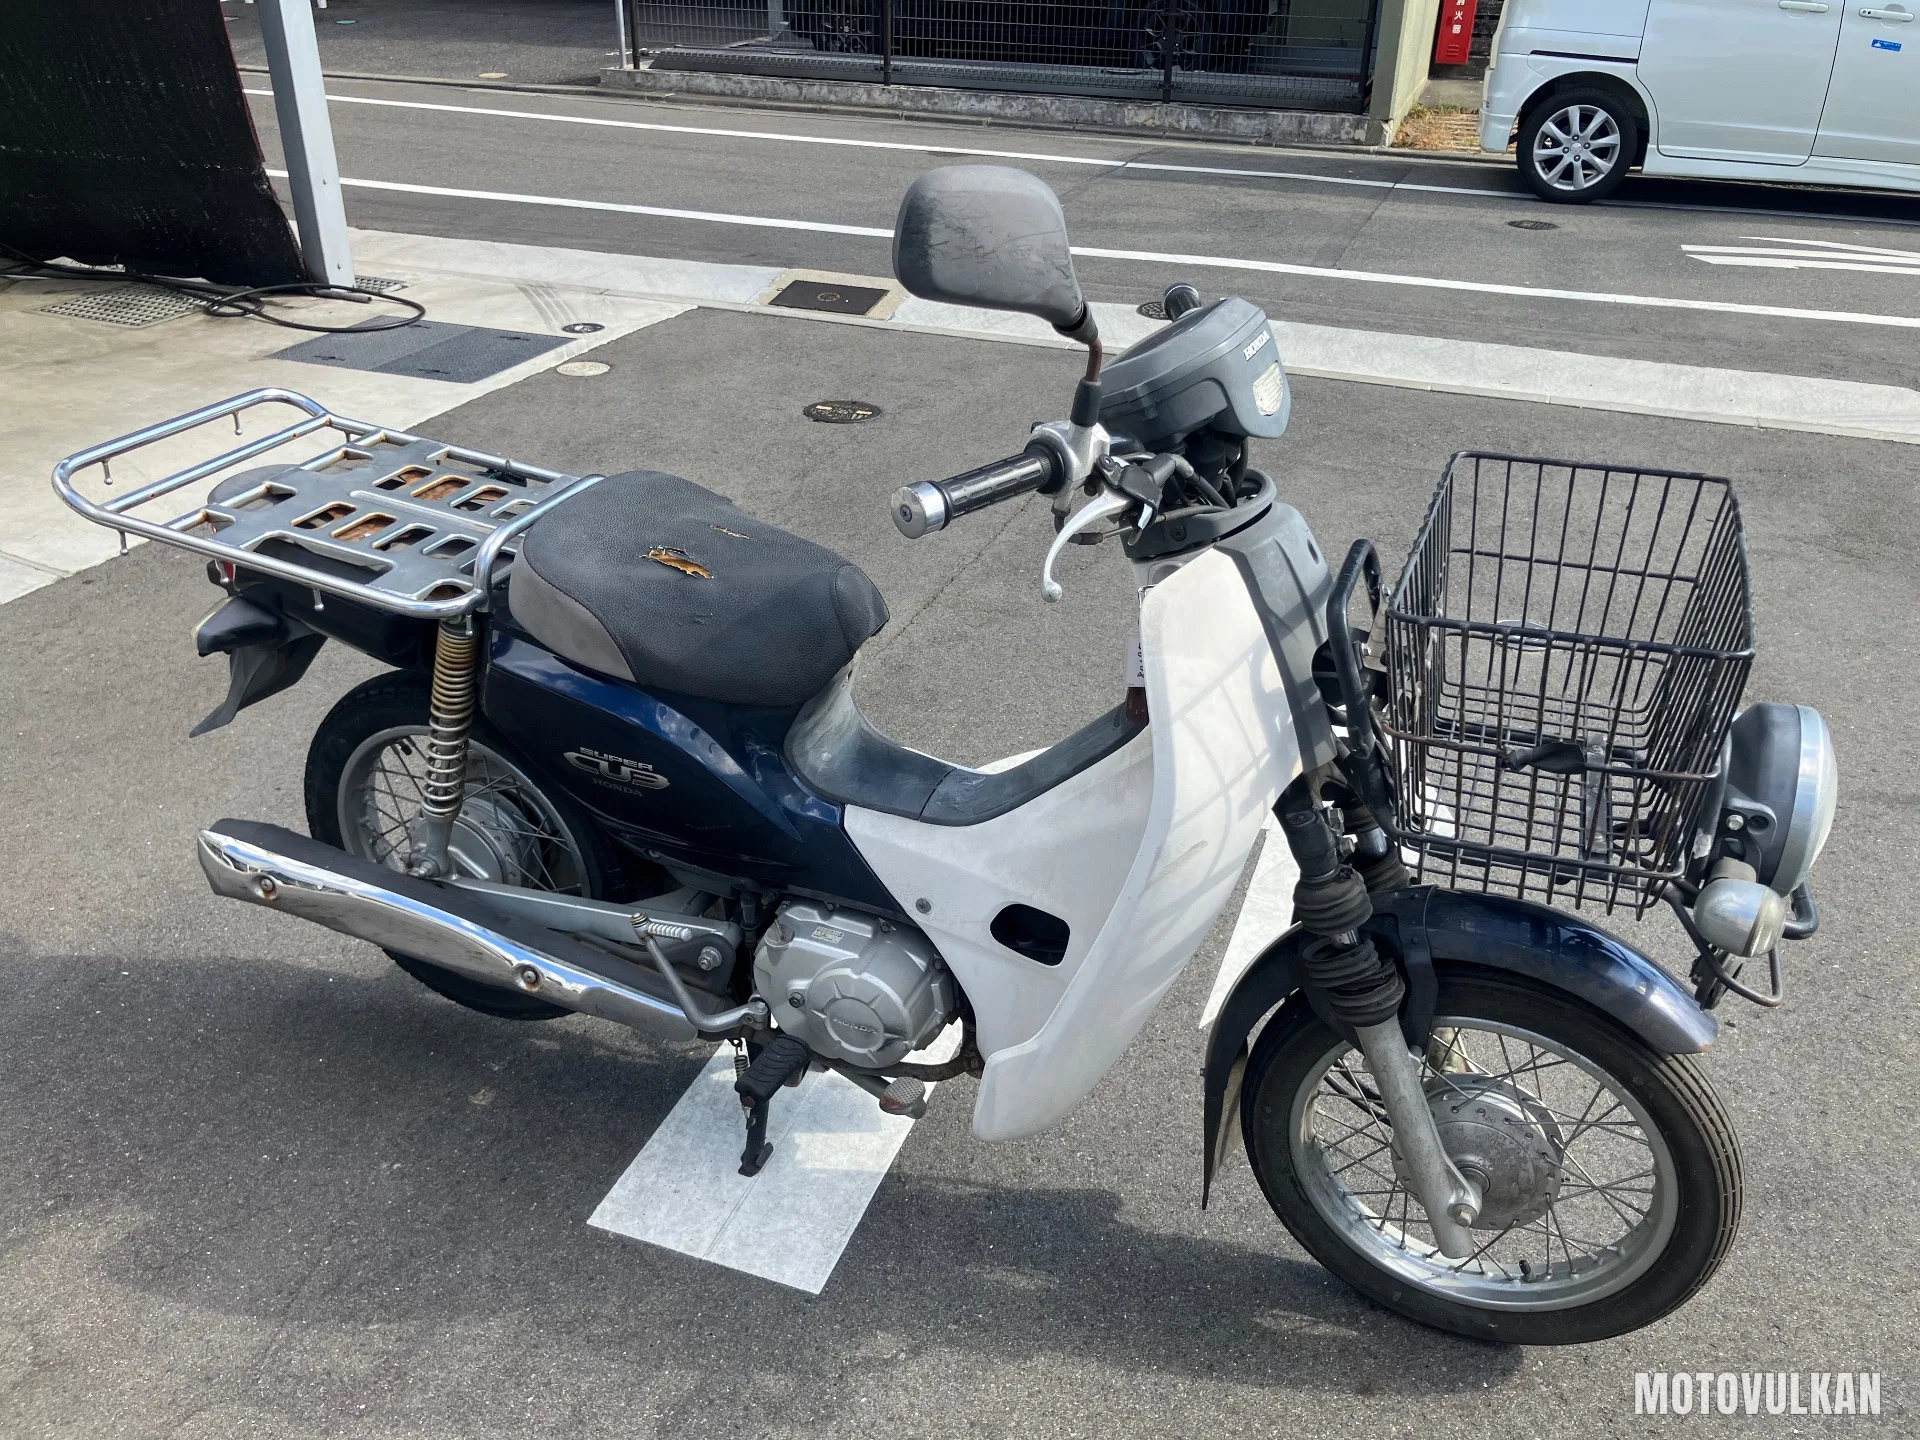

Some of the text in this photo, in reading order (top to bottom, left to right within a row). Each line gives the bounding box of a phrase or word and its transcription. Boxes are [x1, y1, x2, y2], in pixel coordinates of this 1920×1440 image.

[1243, 330, 1270, 361] HONDA
[563, 751, 670, 790] CUB
[580, 746, 653, 771] SUPER
[592, 777, 643, 797] HONDA
[833, 1017, 878, 1034] HONDA
